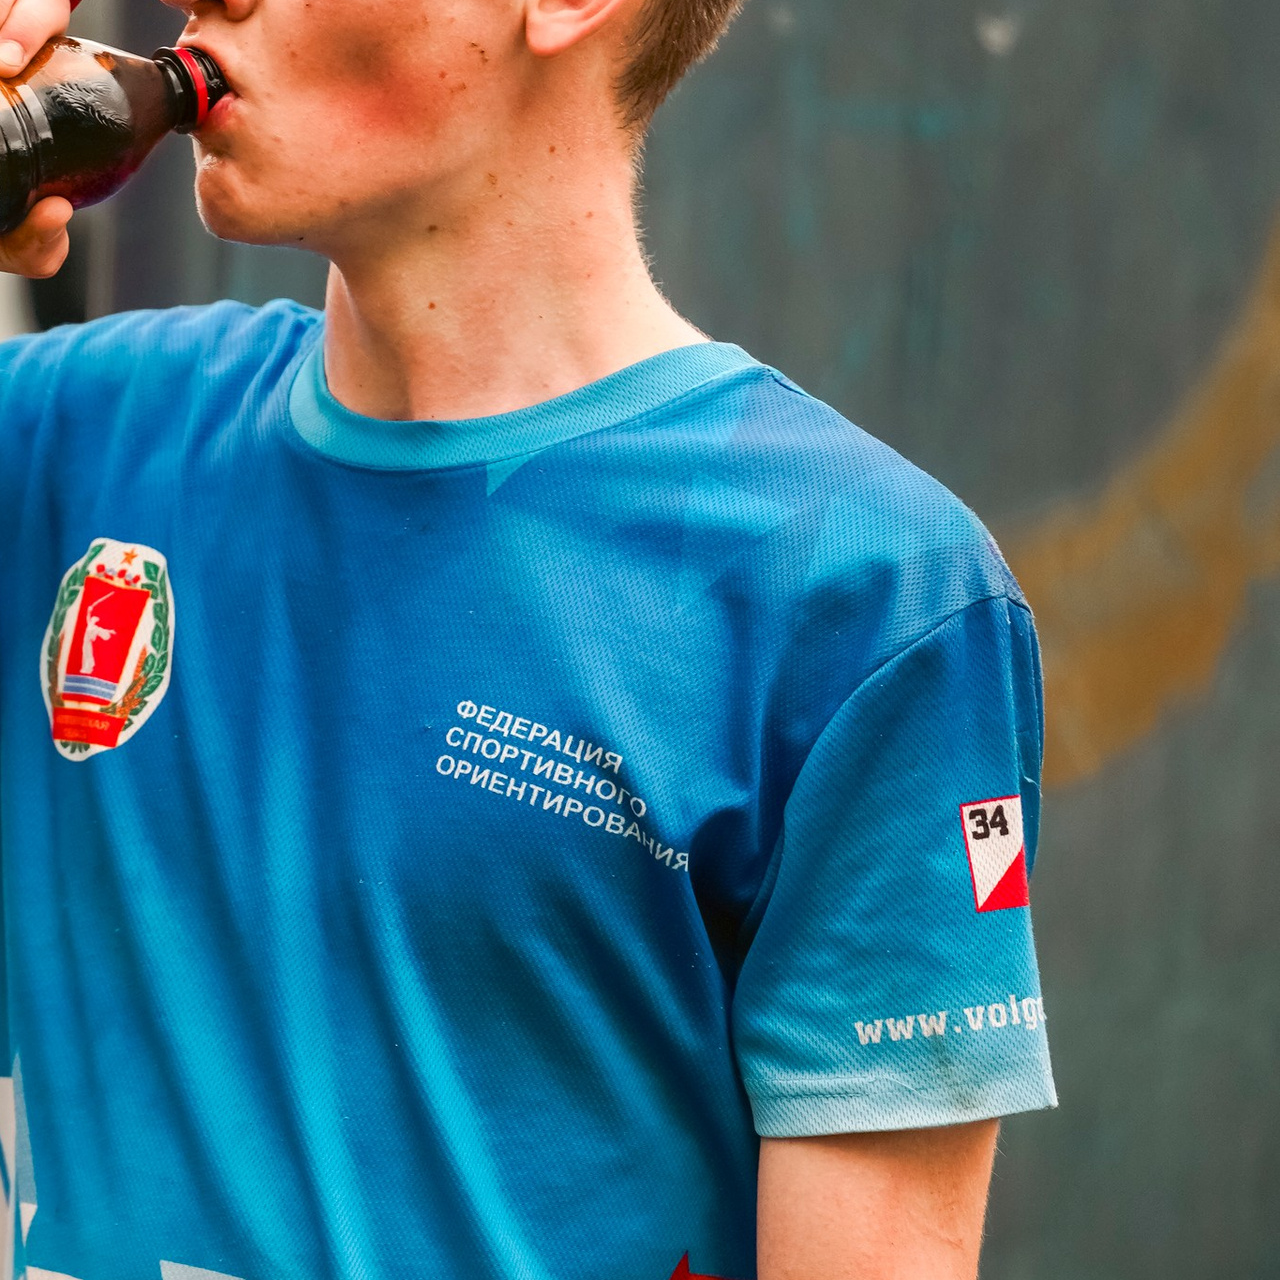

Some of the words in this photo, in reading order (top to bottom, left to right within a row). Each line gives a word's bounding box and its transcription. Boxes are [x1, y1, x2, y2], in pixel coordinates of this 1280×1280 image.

[445, 726, 647, 818] СПОРТИВНОГО
[456, 700, 623, 774] ФЕДЕРАЦИЯ
[435, 755, 689, 872] ОРИЕНТИРОВАНИЯ
[969, 804, 1009, 840] 34
